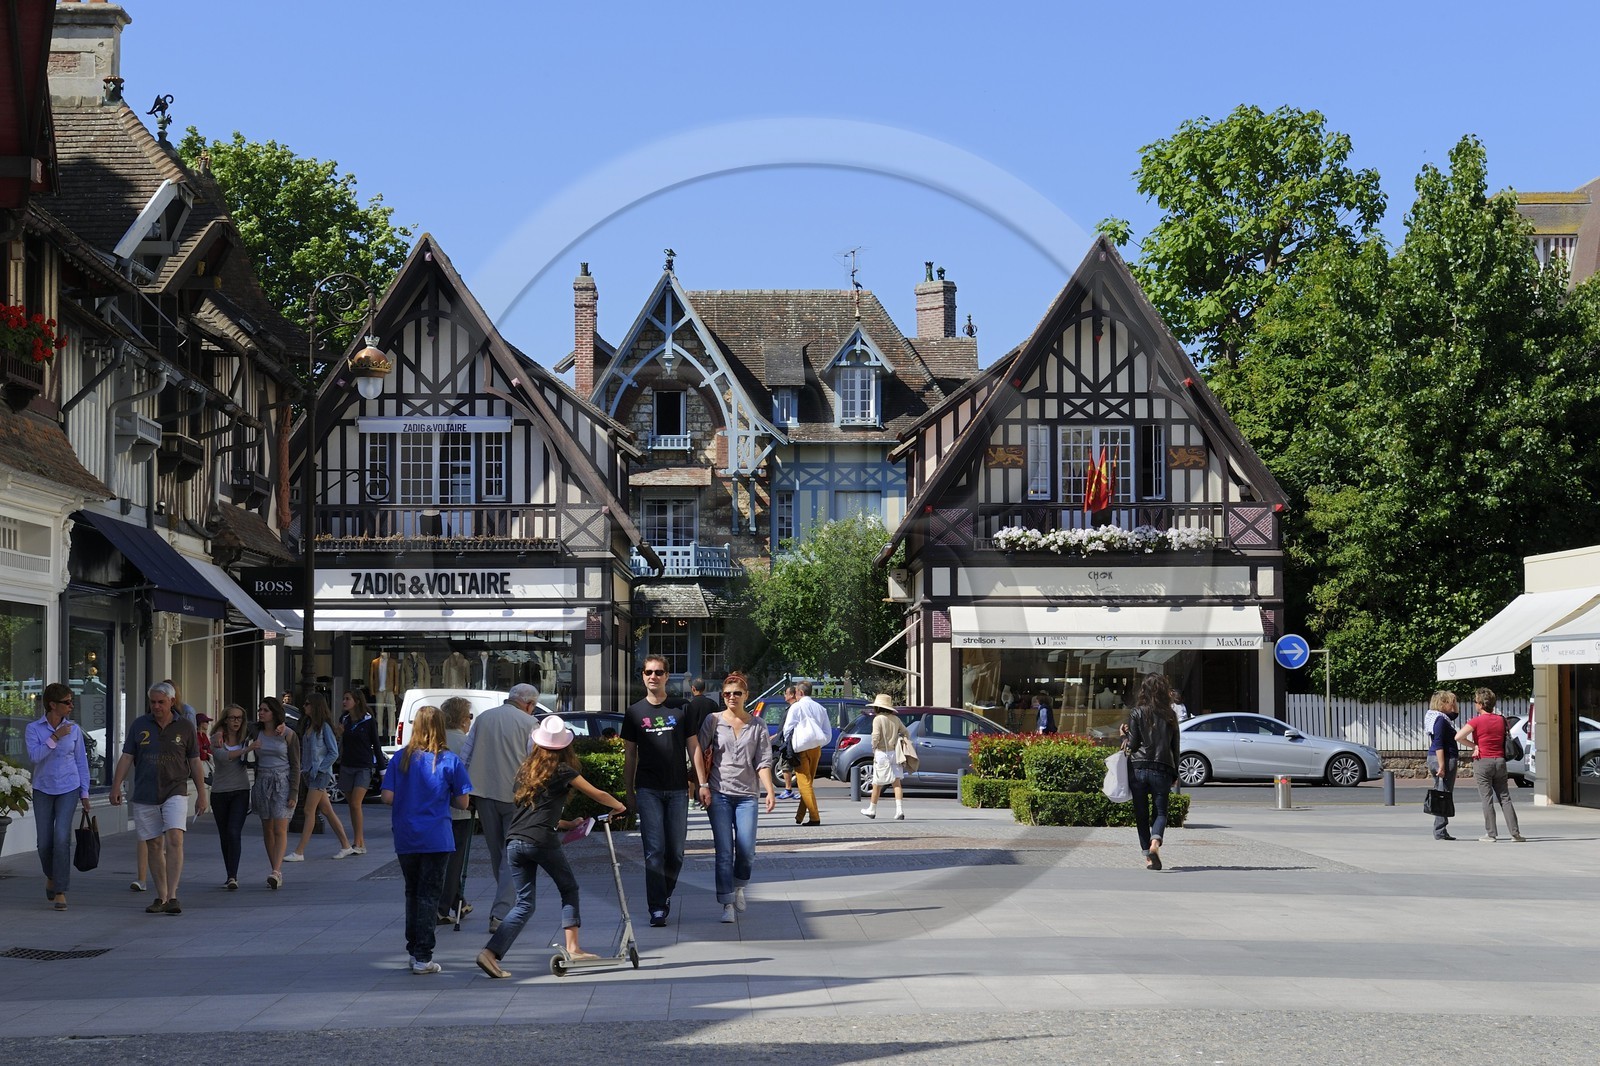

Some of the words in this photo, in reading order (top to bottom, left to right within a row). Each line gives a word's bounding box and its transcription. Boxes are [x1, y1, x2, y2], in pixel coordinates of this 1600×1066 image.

[255, 580, 293, 592] BOSS
[1035, 637, 1047, 645] AJ
[1216, 638, 1255, 647] MaxMara
[139, 731, 151, 745] 2
